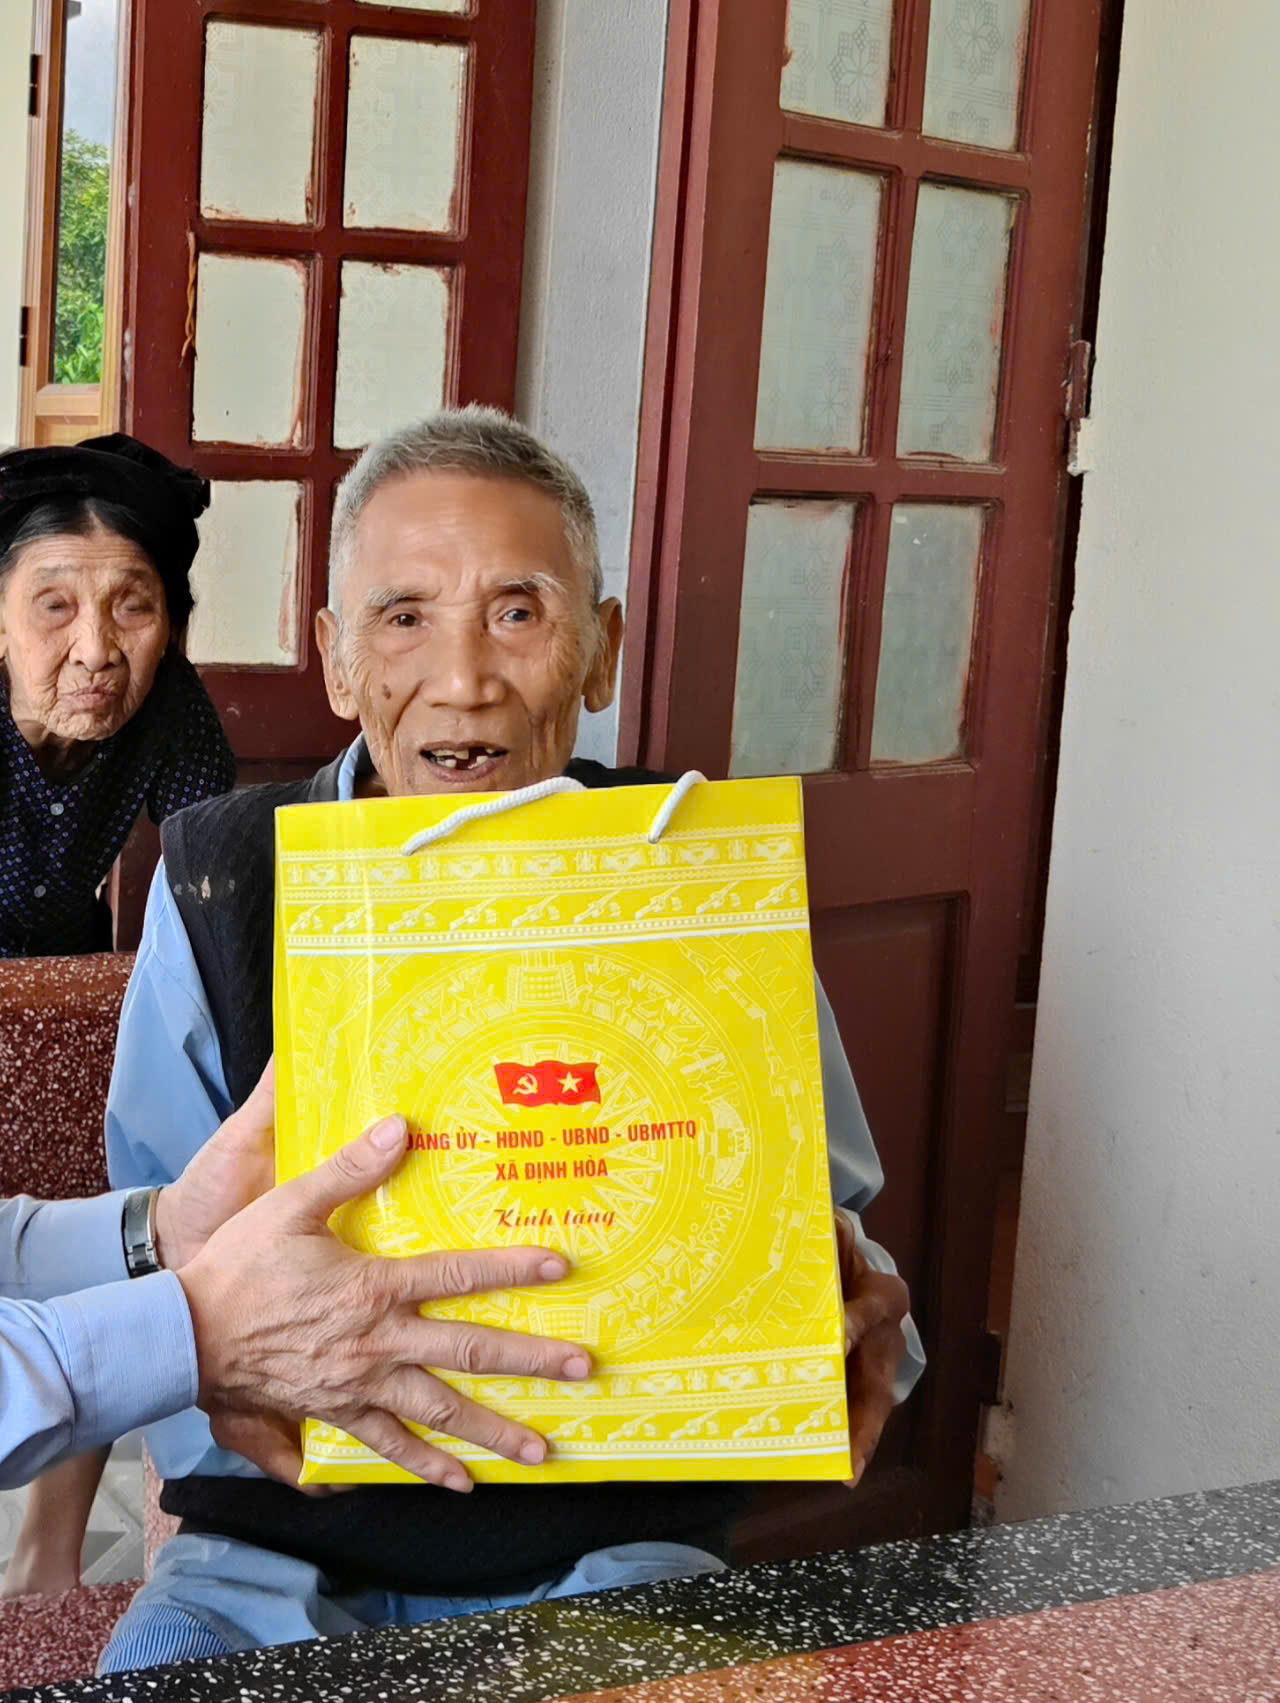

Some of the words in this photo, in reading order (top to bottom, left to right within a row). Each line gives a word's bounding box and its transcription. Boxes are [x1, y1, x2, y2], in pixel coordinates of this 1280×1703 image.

[496, 1130, 544, 1149] HĐND
[562, 1126, 610, 1146] UBND
[628, 1120, 696, 1142] UBMTTQ
[496, 1160, 519, 1180] XÃ
[524, 1161, 567, 1184] ĐỊNH
